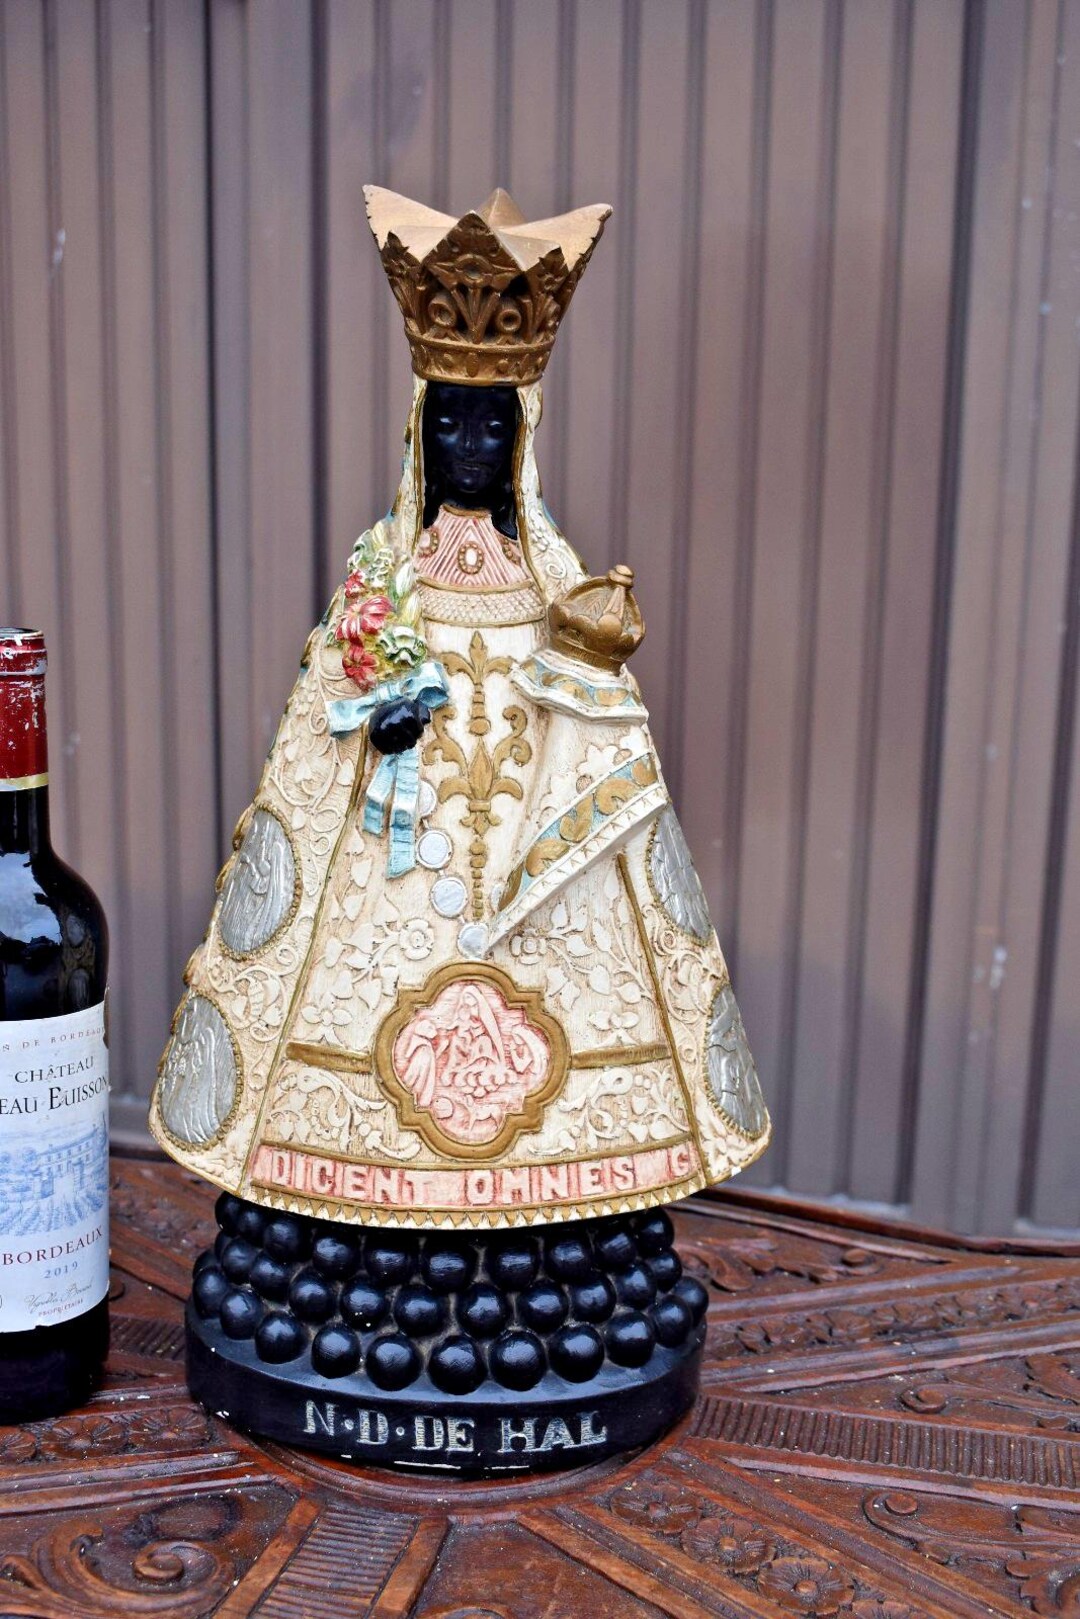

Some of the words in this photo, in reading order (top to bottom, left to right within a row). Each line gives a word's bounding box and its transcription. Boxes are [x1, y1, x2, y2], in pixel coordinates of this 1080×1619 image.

[22, 1040, 40, 1049] DE
[14, 1056, 94, 1083] CHÂTEAU
[271, 1150, 431, 1205] DICENT
[465, 1156, 635, 1205] OMNES
[3, 1225, 103, 1266] BORDEAUX
[44, 1261, 78, 1279] 2019
[497, 1411, 608, 1453] HAL
